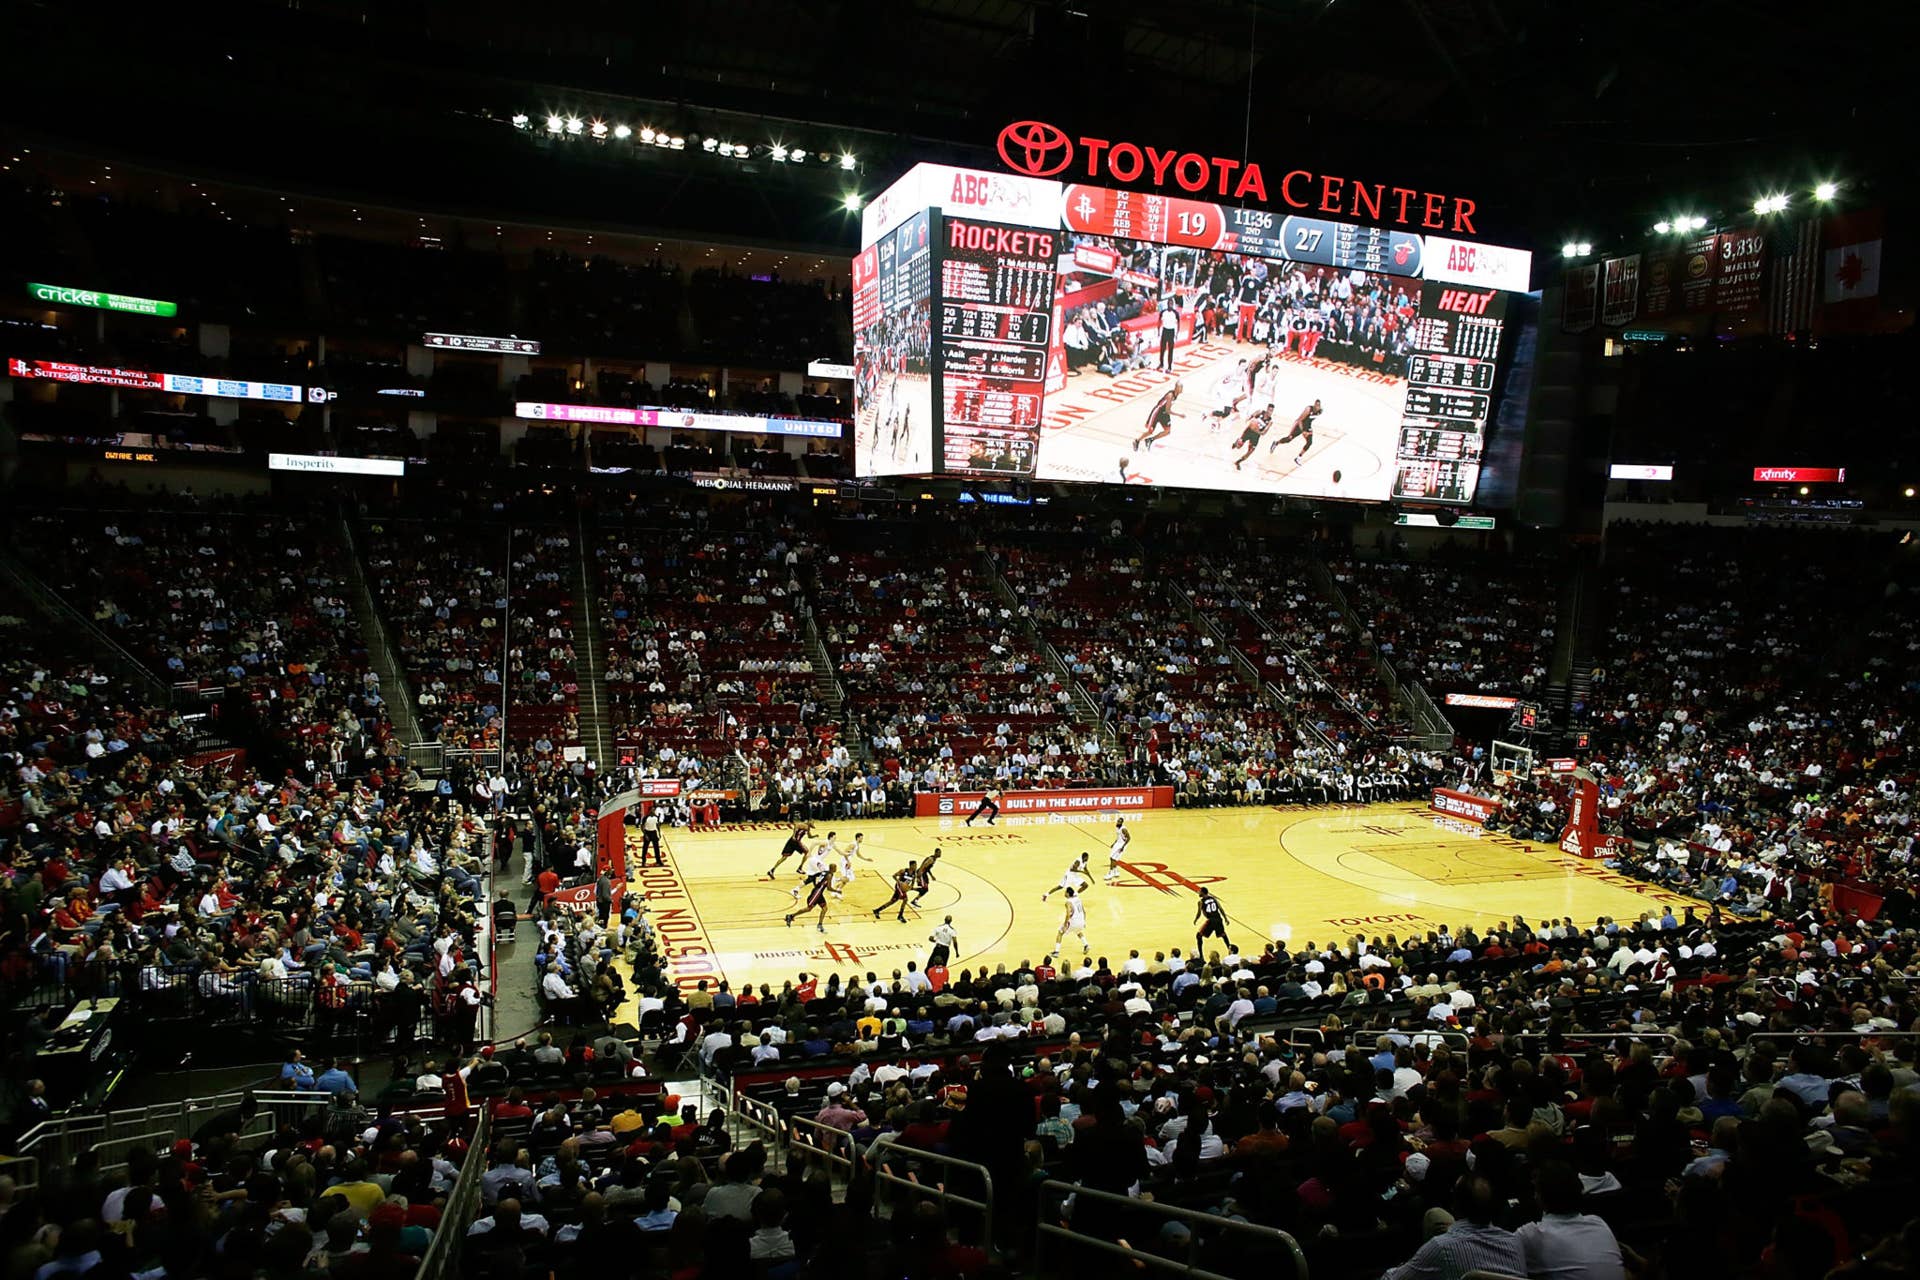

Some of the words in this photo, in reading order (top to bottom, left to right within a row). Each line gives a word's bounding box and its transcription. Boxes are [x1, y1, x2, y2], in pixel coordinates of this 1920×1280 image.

[951, 173, 988, 205] ABC
[1079, 136, 1268, 200] TOYOTA
[1283, 171, 1477, 234] CENTER
[1117, 192, 1128, 200] FG
[1178, 212, 1206, 236] 19
[1234, 209, 1272, 229] 11:36
[949, 220, 1053, 258] ROCKETS
[1295, 228, 1323, 251] 27
[1723, 236, 1763, 260] 3,830
[1447, 244, 1476, 272] ABC
[37, 287, 100, 306] cricket
[1438, 290, 1497, 315] HEAT
[105, 300, 156, 313] WIRELESS
[944, 308, 955, 316] FG
[962, 310, 977, 319] 7/21
[943, 325, 953, 333] FT
[1009, 323, 1020, 331] TO
[1000, 355, 1026, 364] Harden
[35, 367, 162, 388] SUITES@ROCKETBALL.COM
[51, 362, 88, 373] ROCKETS
[115, 369, 148, 379] RENTALS
[785, 423, 835, 434] UNITED
[286, 457, 335, 469] Insperity
[1760, 469, 1796, 480] xfinity
[696, 478, 742, 490] MEMORIAL
[745, 480, 791, 491] HERMANN
[1522, 714, 1534, 726] 24
[959, 800, 1000, 809] TUNA
[1007, 799, 1033, 809] BUILT
[1036, 799, 1046, 808] IN
[1048, 798, 1067, 807] THE
[1069, 797, 1099, 807] HEART
[1101, 797, 1113, 806] OF
[1114, 796, 1144, 806] TEXAS
[931, 833, 1023, 841] TOYOTA
[1562, 840, 1583, 856] PEAK
[1205, 902, 1217, 913] 40
[1322, 913, 1425, 927] TOYOTA
[754, 949, 825, 960] HOUSTON
[855, 942, 923, 953] ROCKETS
